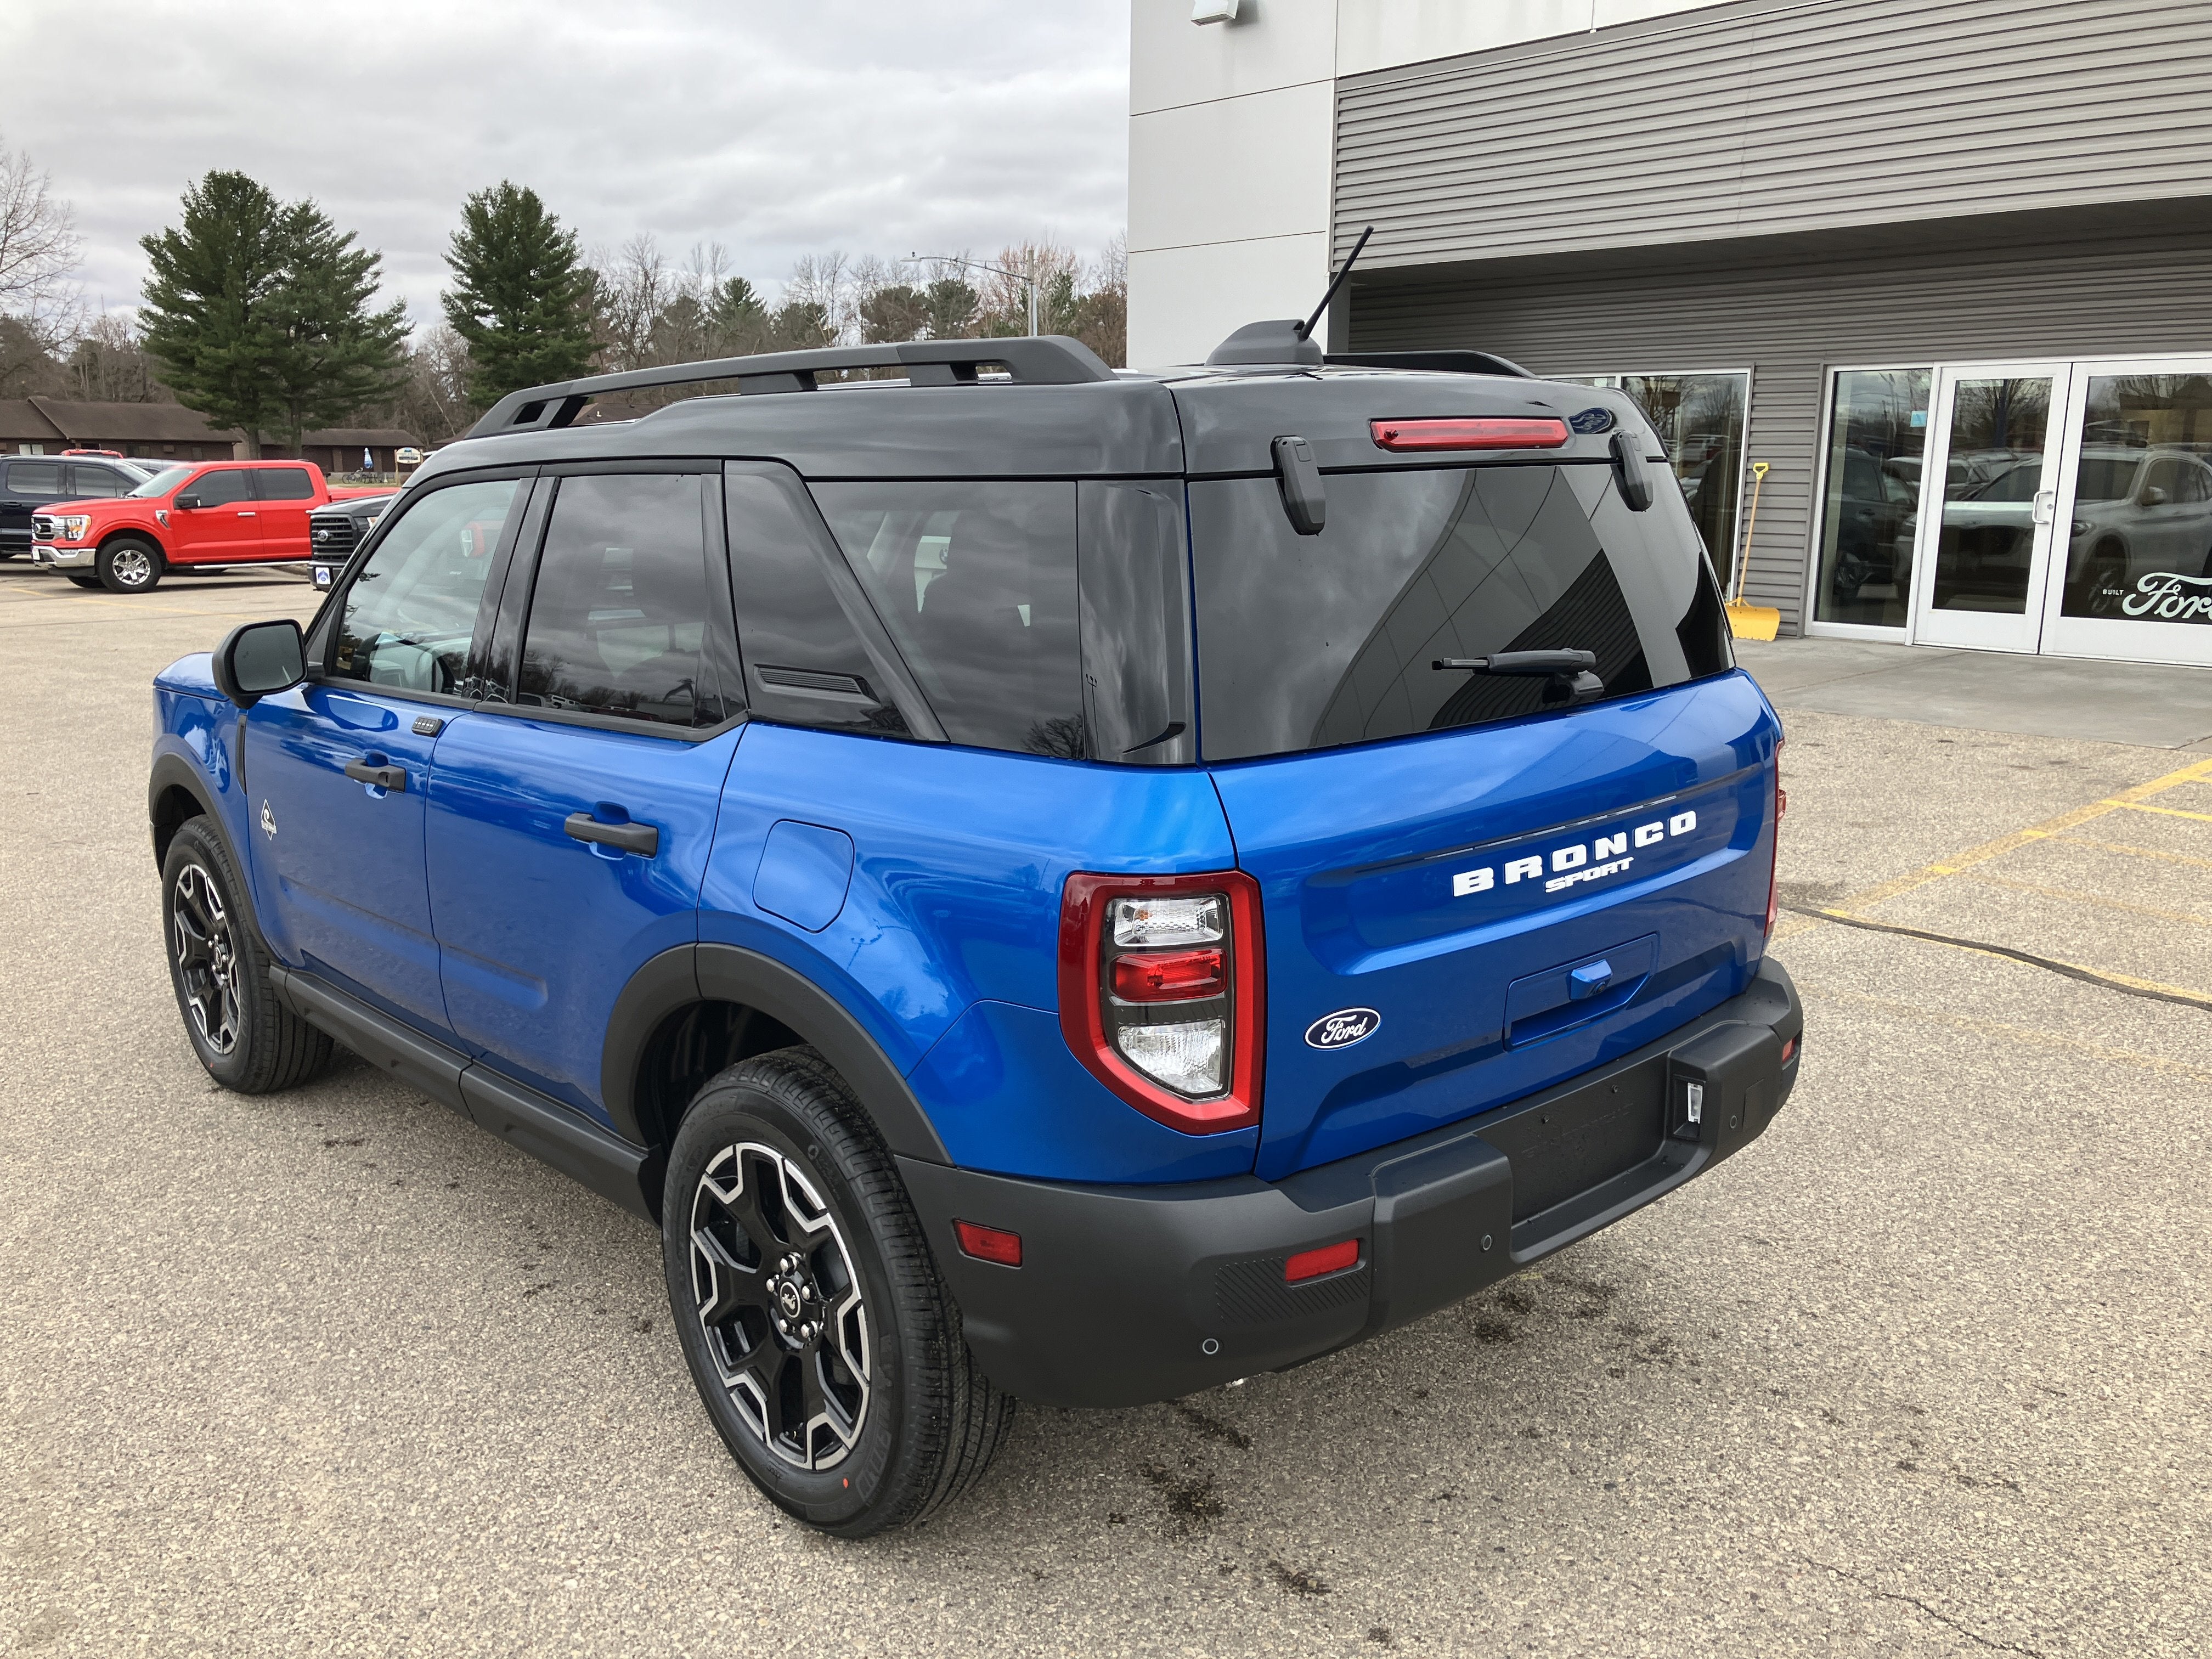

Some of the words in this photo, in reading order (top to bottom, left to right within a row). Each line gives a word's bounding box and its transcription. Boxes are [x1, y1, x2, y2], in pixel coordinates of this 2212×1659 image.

[2122, 572, 2212, 621] For
[1453, 810, 1696, 897] BRONCO
[1544, 856, 1634, 893] SPORT
[1321, 1014, 1368, 1044] Ford
